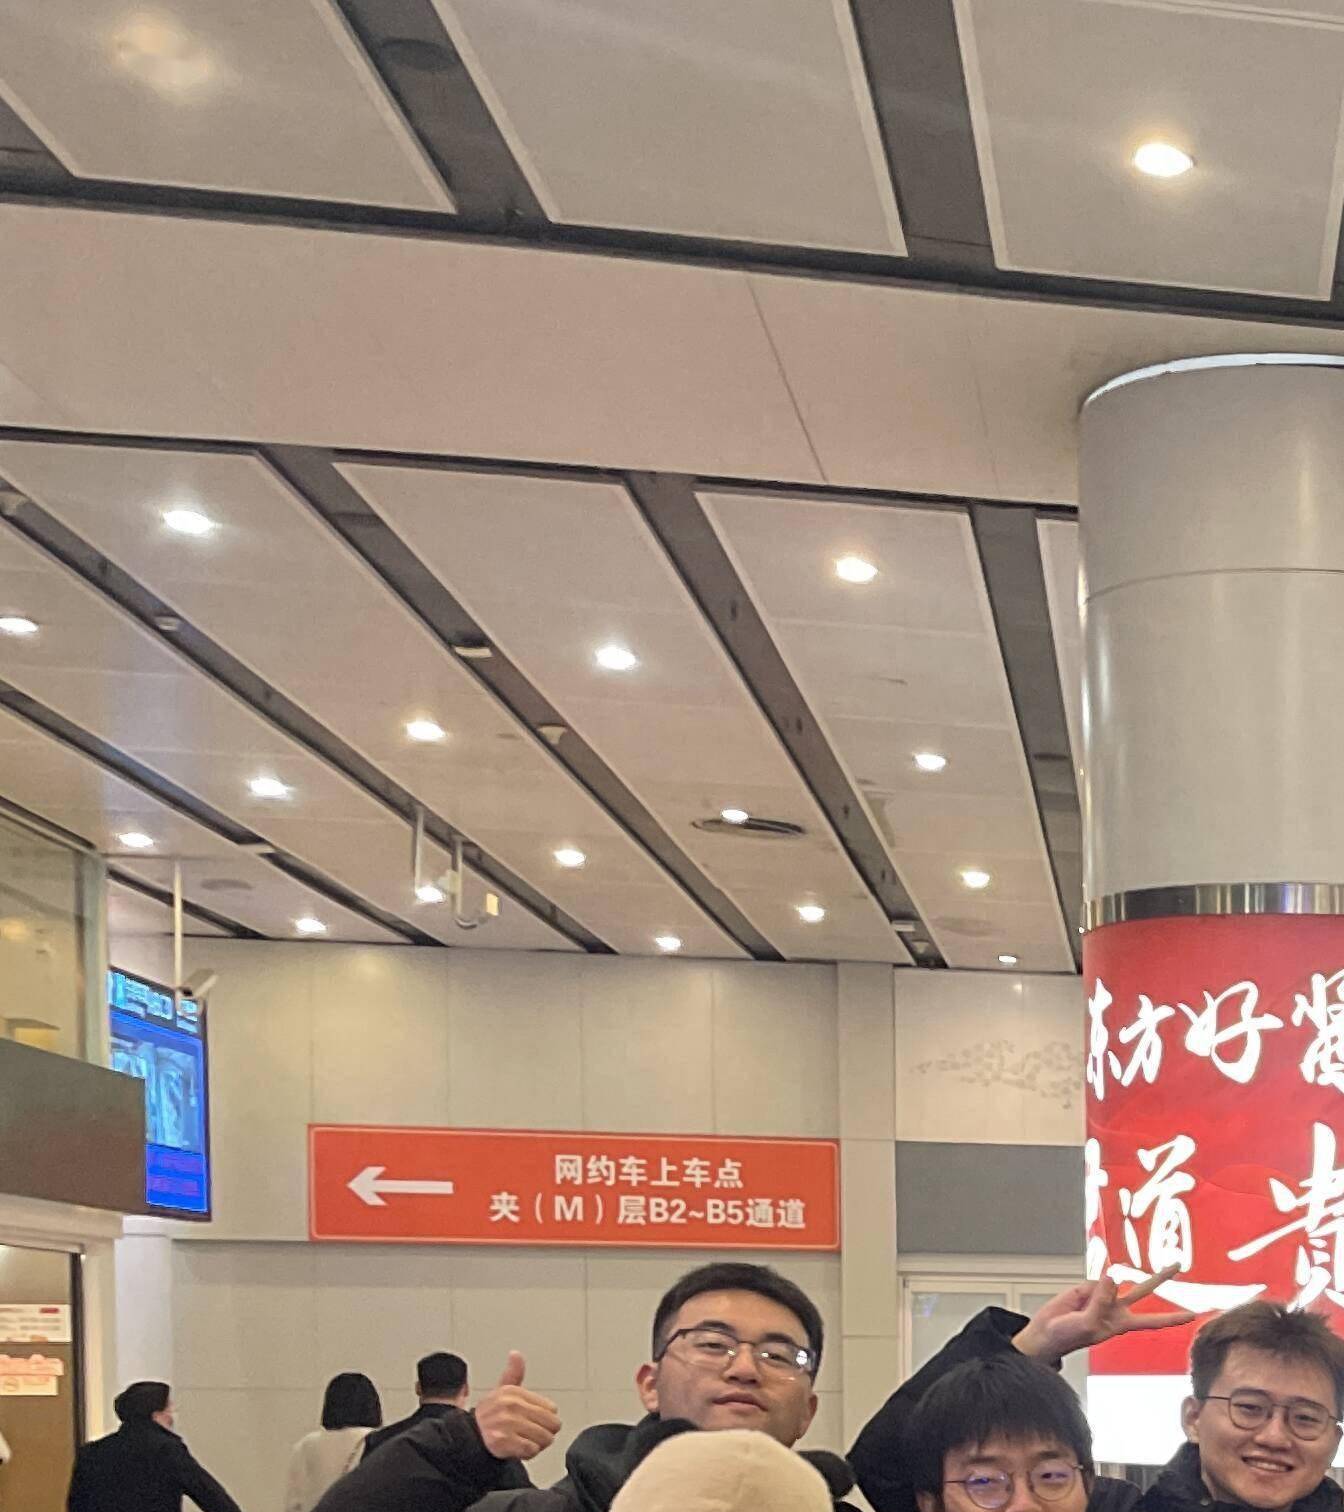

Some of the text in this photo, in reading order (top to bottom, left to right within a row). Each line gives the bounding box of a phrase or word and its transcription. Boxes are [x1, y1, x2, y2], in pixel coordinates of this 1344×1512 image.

[555, 1154, 743, 1189] 网约车上车点
